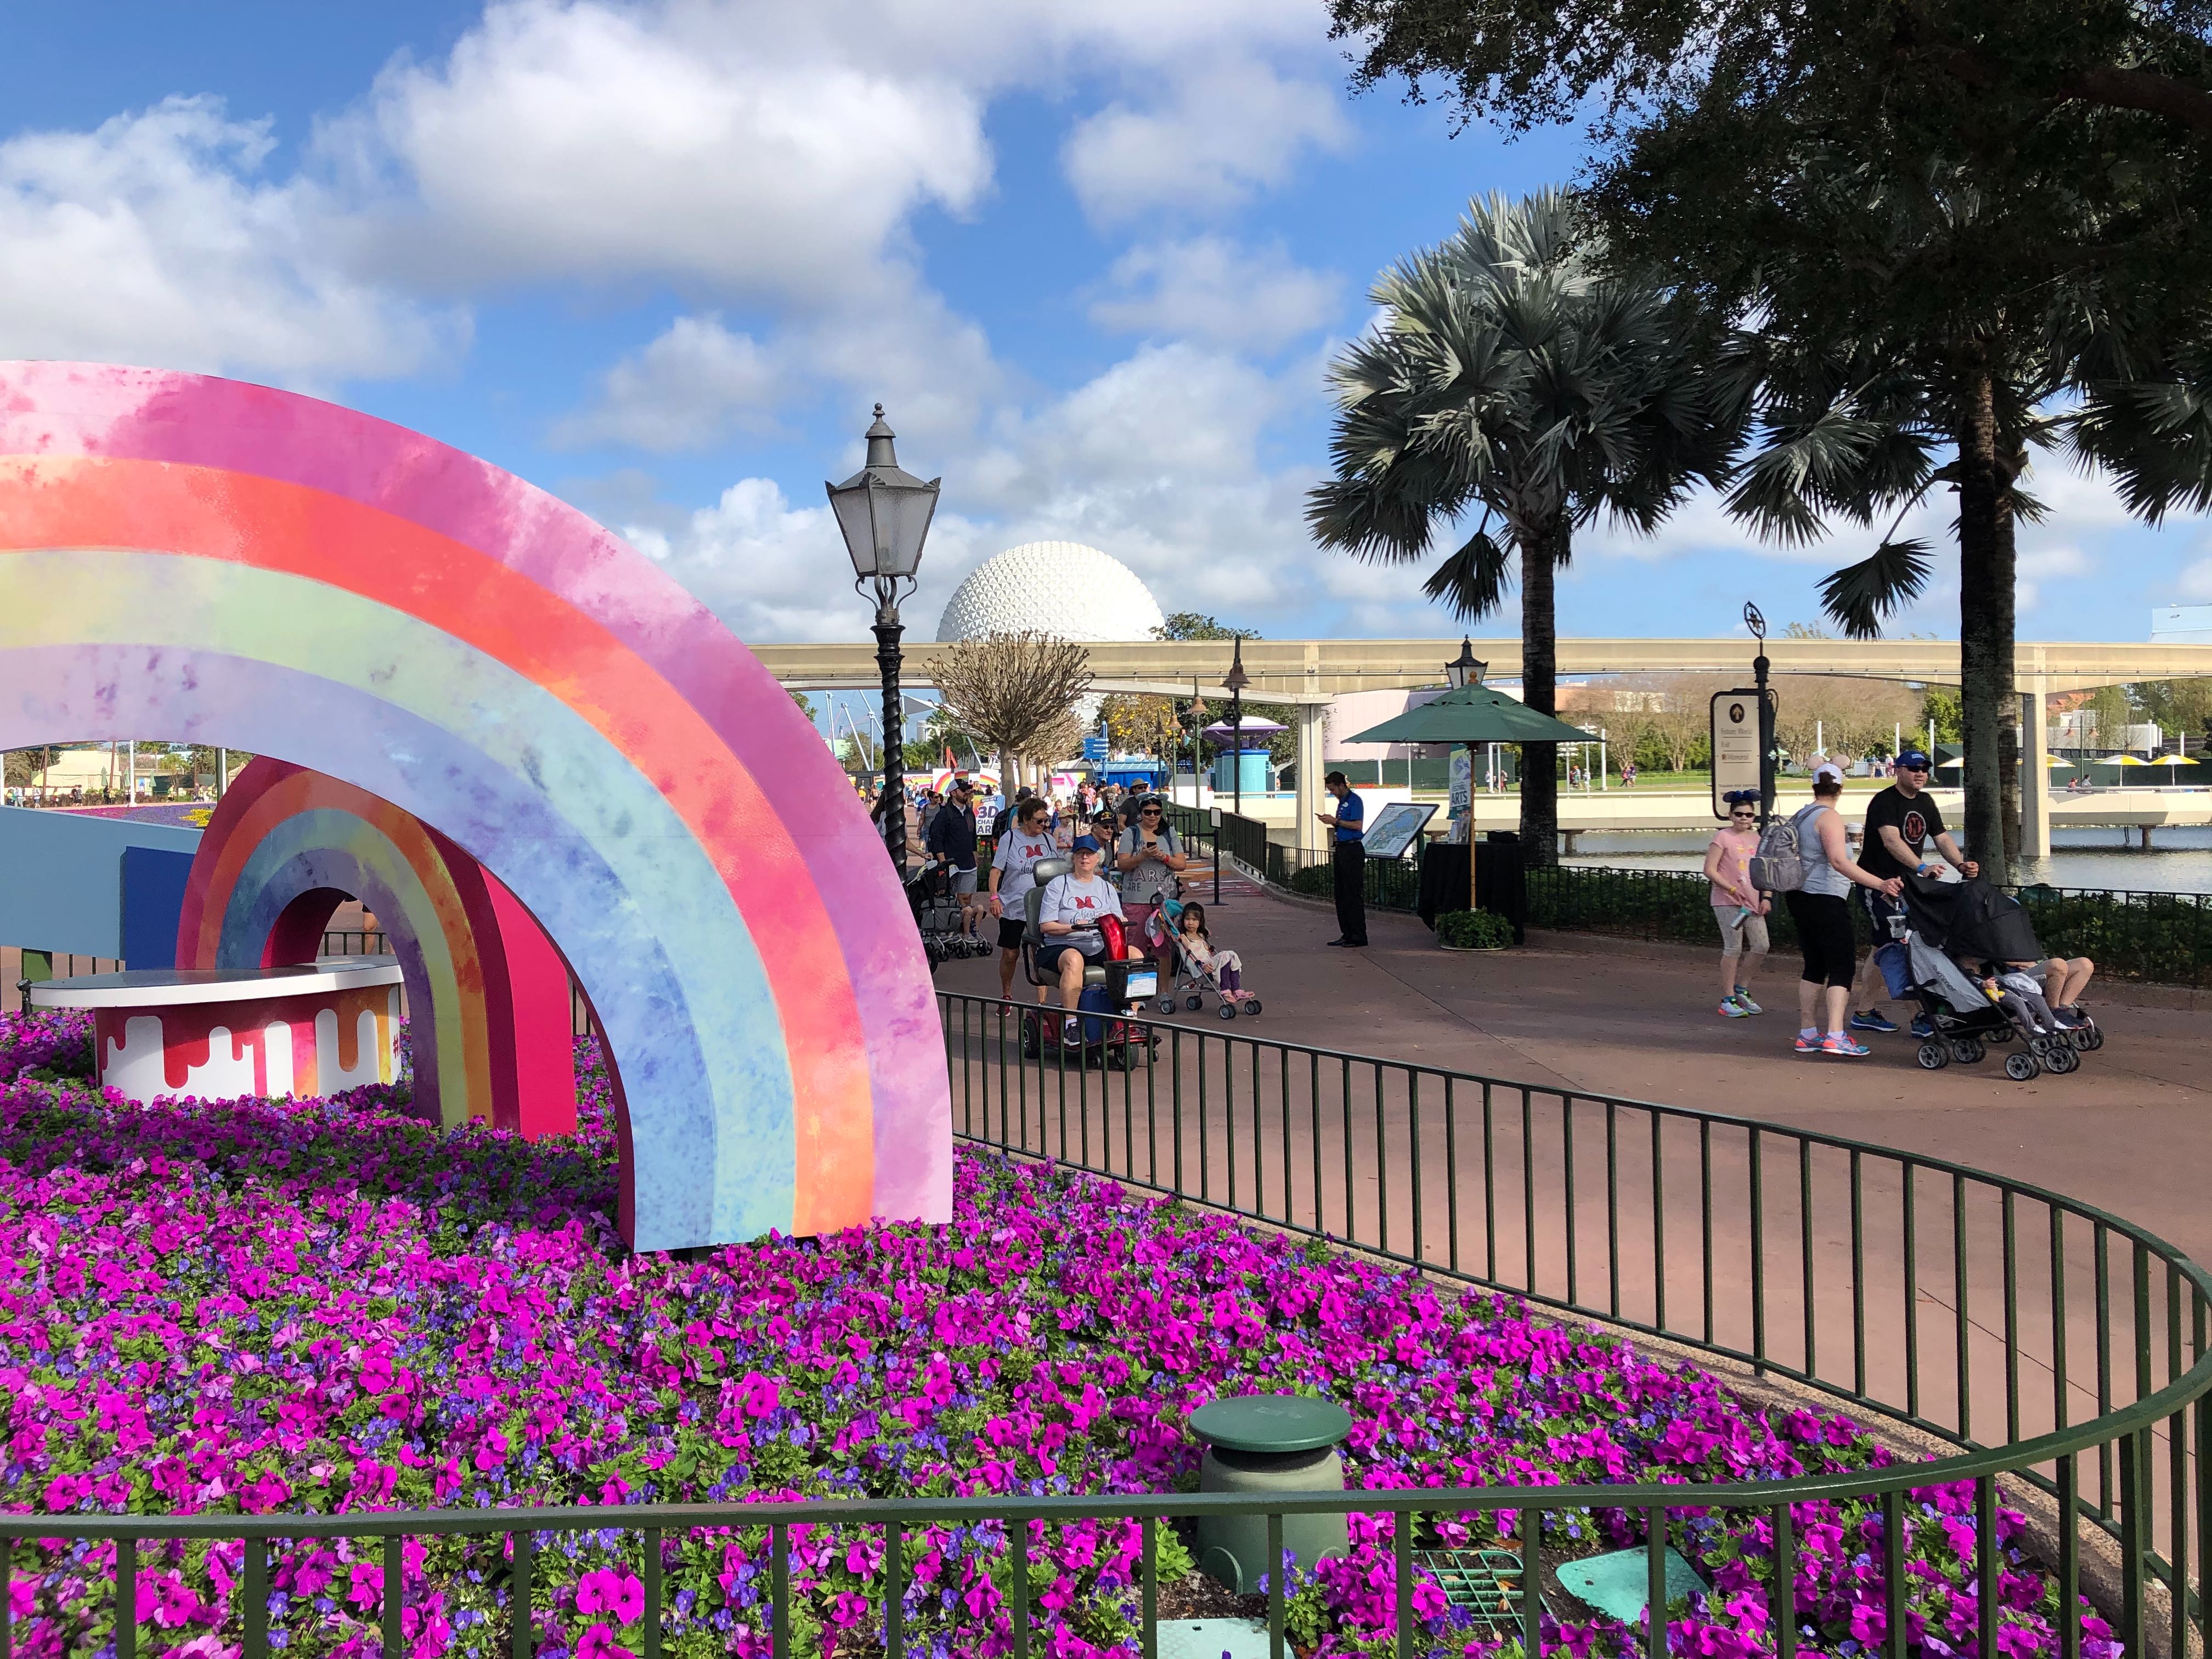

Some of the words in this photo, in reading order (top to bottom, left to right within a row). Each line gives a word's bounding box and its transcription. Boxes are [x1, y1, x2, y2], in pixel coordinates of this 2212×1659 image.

[1452, 791, 1468, 805] ARTS
[978, 805, 999, 819] 3D
[977, 825, 991, 834] AR
[1127, 882, 1141, 892] ARE
